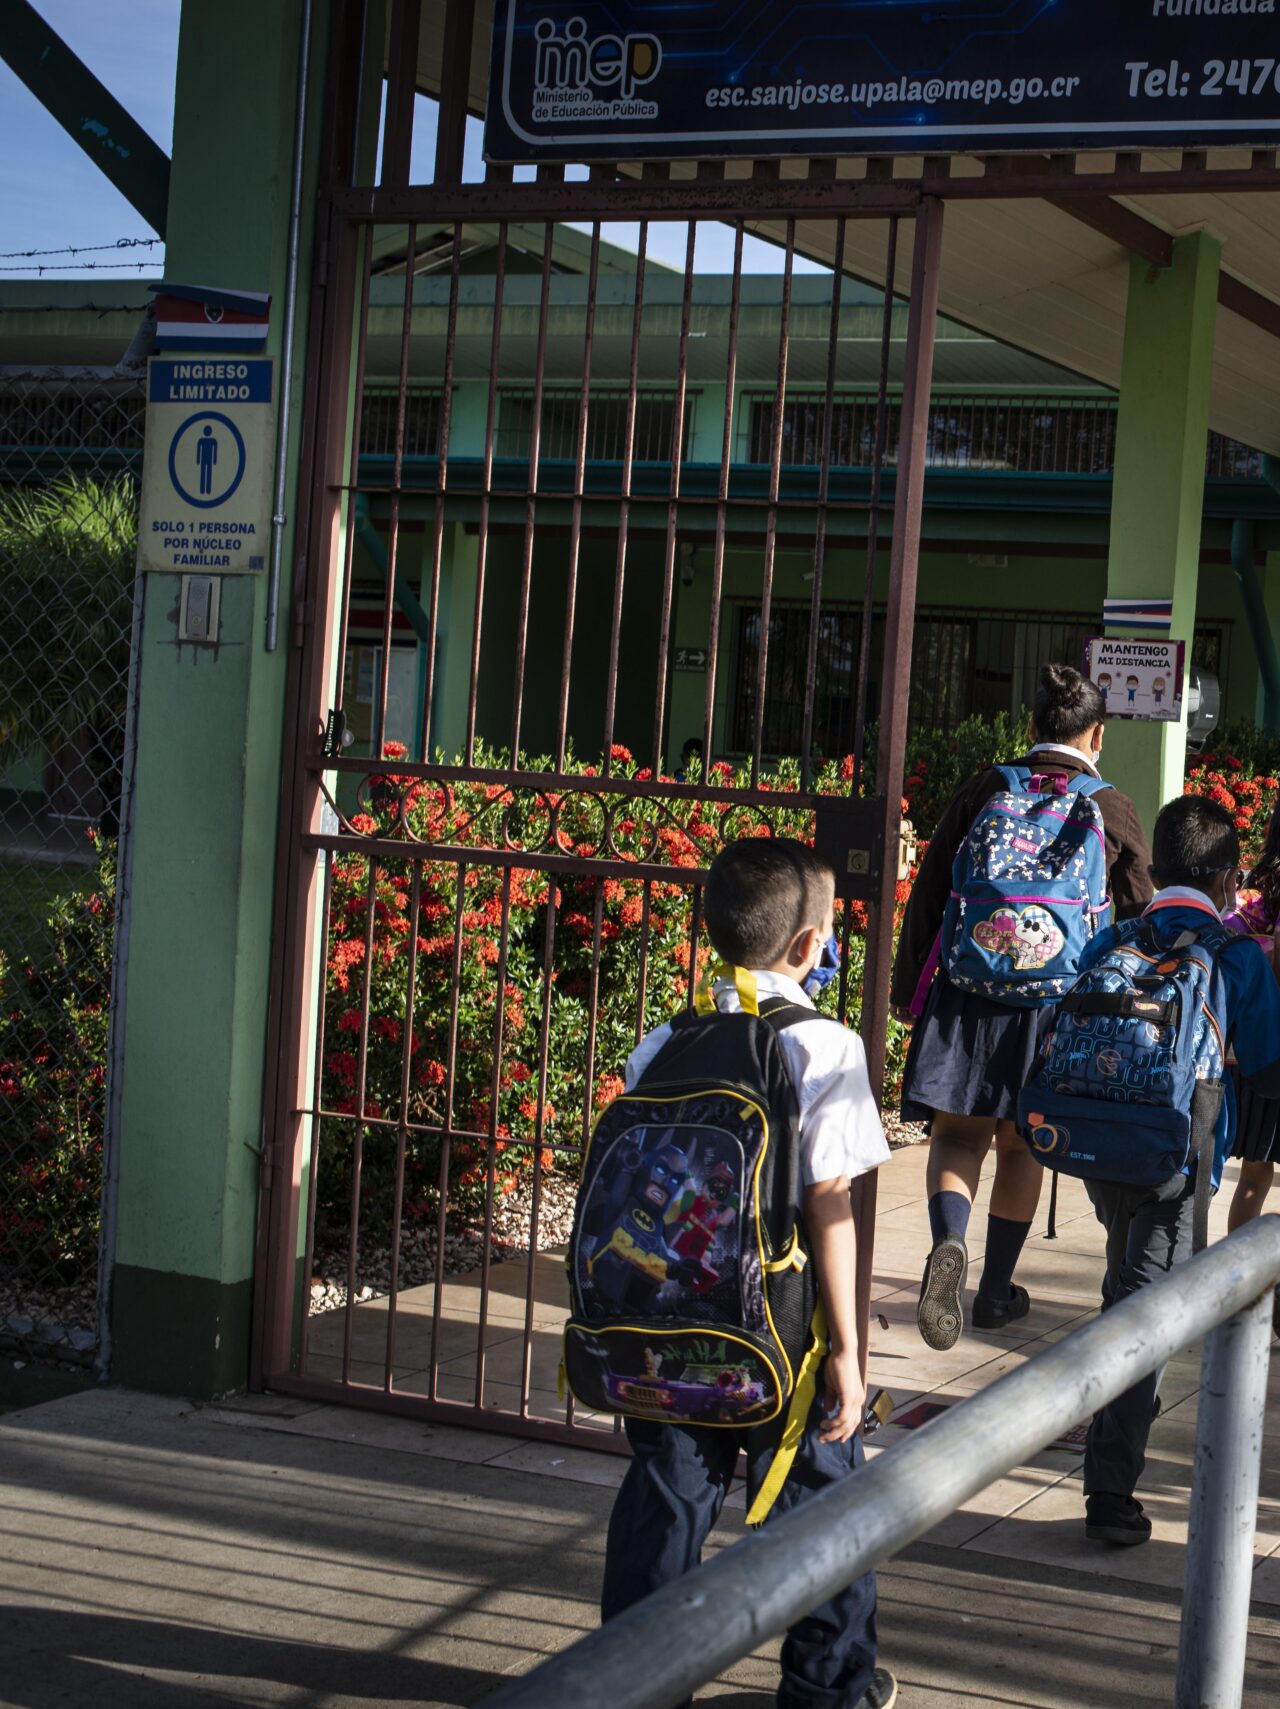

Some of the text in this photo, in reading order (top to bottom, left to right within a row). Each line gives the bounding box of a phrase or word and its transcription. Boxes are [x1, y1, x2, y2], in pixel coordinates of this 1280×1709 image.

[534, 16, 662, 97] mep
[1125, 61, 1190, 98] Tel:
[536, 90, 590, 103] Ministerio
[705, 75, 1080, 111] esc.sanjose.upala@mep.go.cr
[535, 103, 656, 118] de Educación Pública
[173, 364, 248, 379] INGRESO
[169, 385, 250, 400] LIMITADO
[152, 521, 256, 534] SOLO 1 PERSONA
[164, 535, 242, 550] POR NÚCLEO
[173, 555, 230, 566] FAMILIAR
[1101, 643, 1168, 656] MANTENGO
[1098, 657, 1171, 668] MI DISTANCIA
